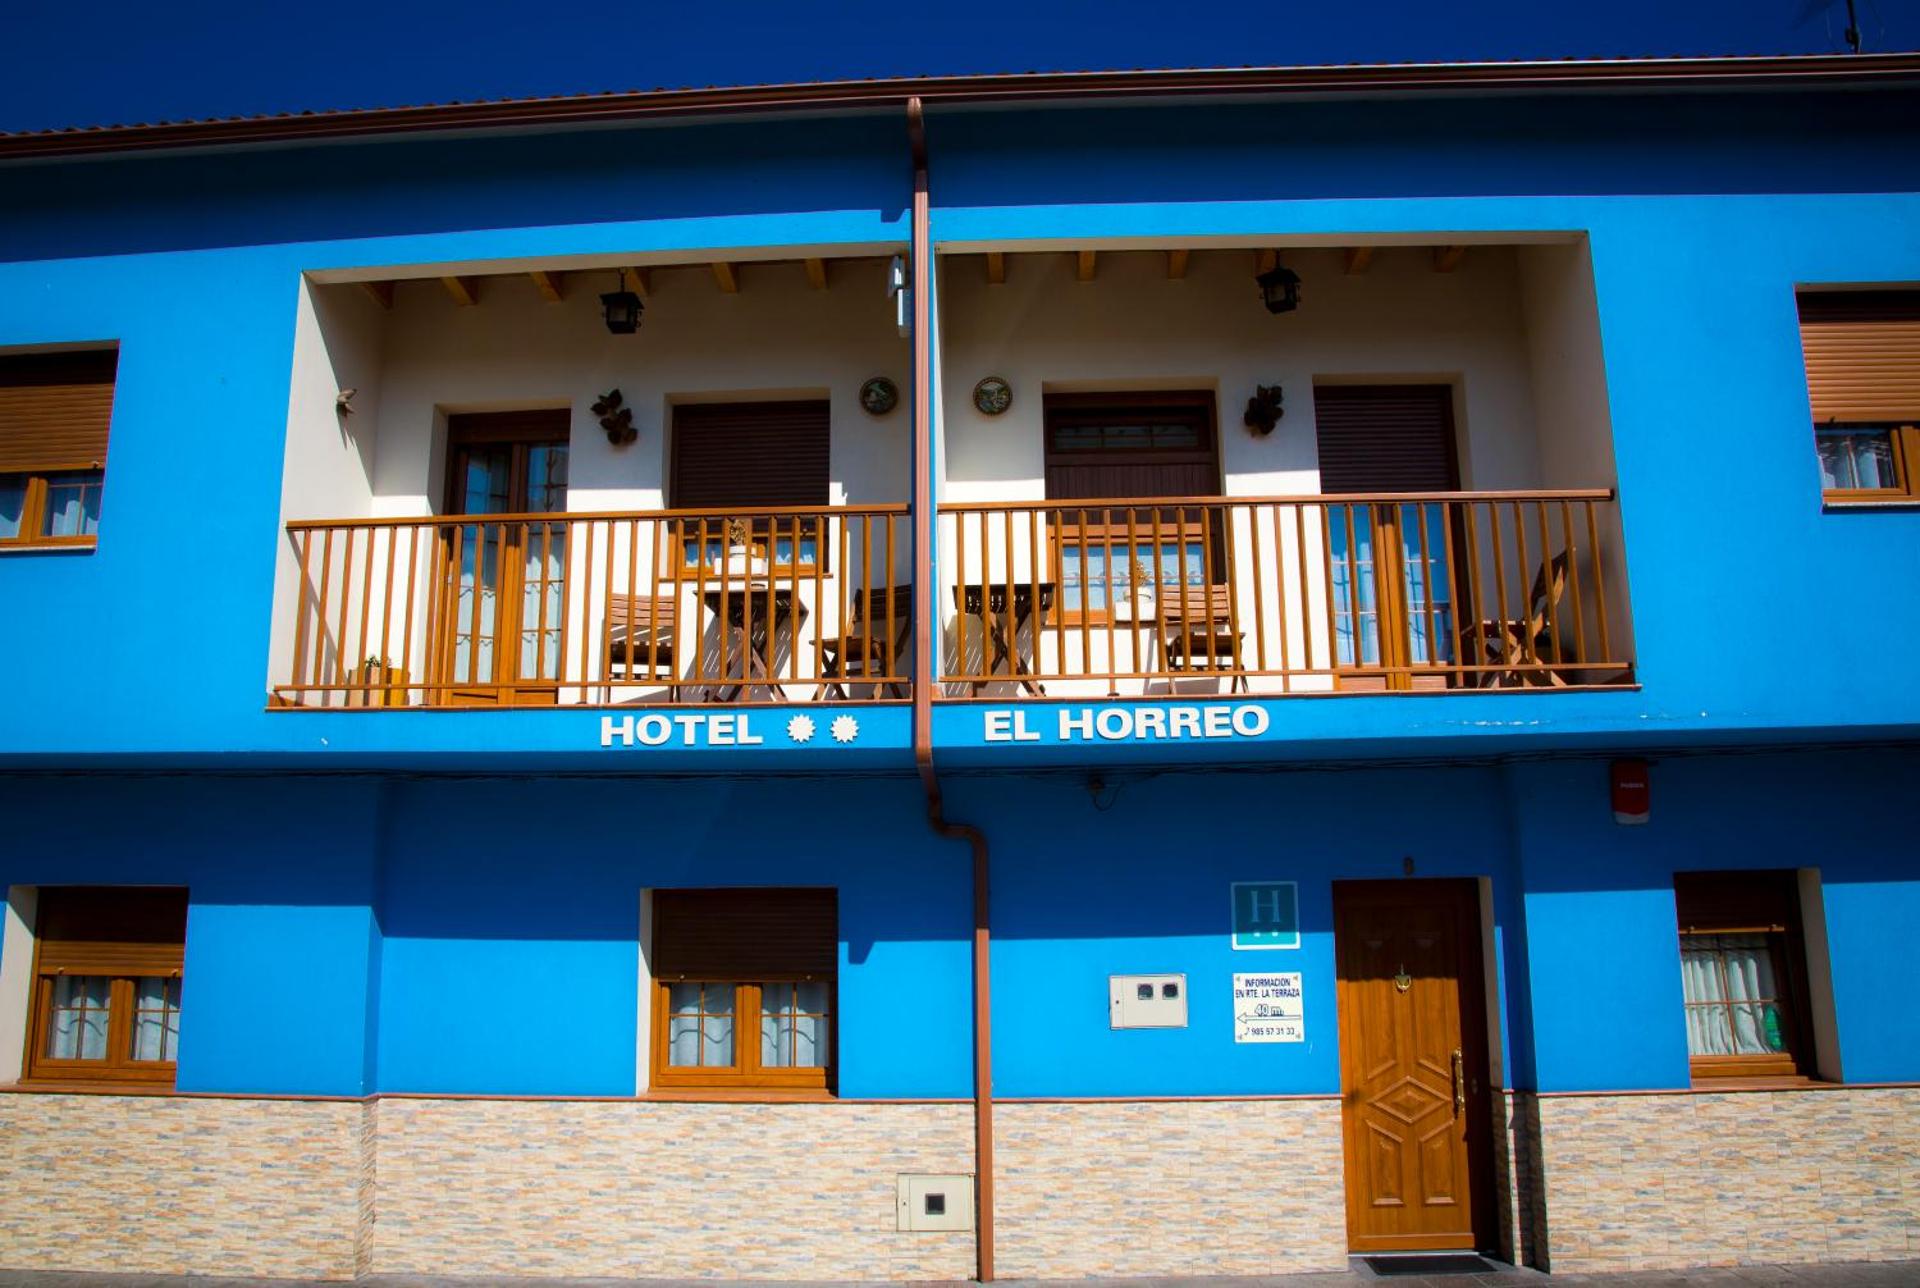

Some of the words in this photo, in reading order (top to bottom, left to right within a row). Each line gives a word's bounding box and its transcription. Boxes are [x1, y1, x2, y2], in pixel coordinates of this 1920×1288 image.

[602, 714, 763, 746] HOTEL
[985, 710, 1041, 741] EL
[1059, 704, 1270, 740] HORREO
[1250, 890, 1280, 922] H
[1235, 989, 1244, 998] EN
[1262, 989, 1270, 998] LA
[1271, 988, 1300, 998] TERRAZA
[1254, 1003, 1269, 1017] 40
[1251, 1027, 1264, 1035] 985
[1266, 1027, 1275, 1035] 57
[1276, 1027, 1284, 1035] 31
